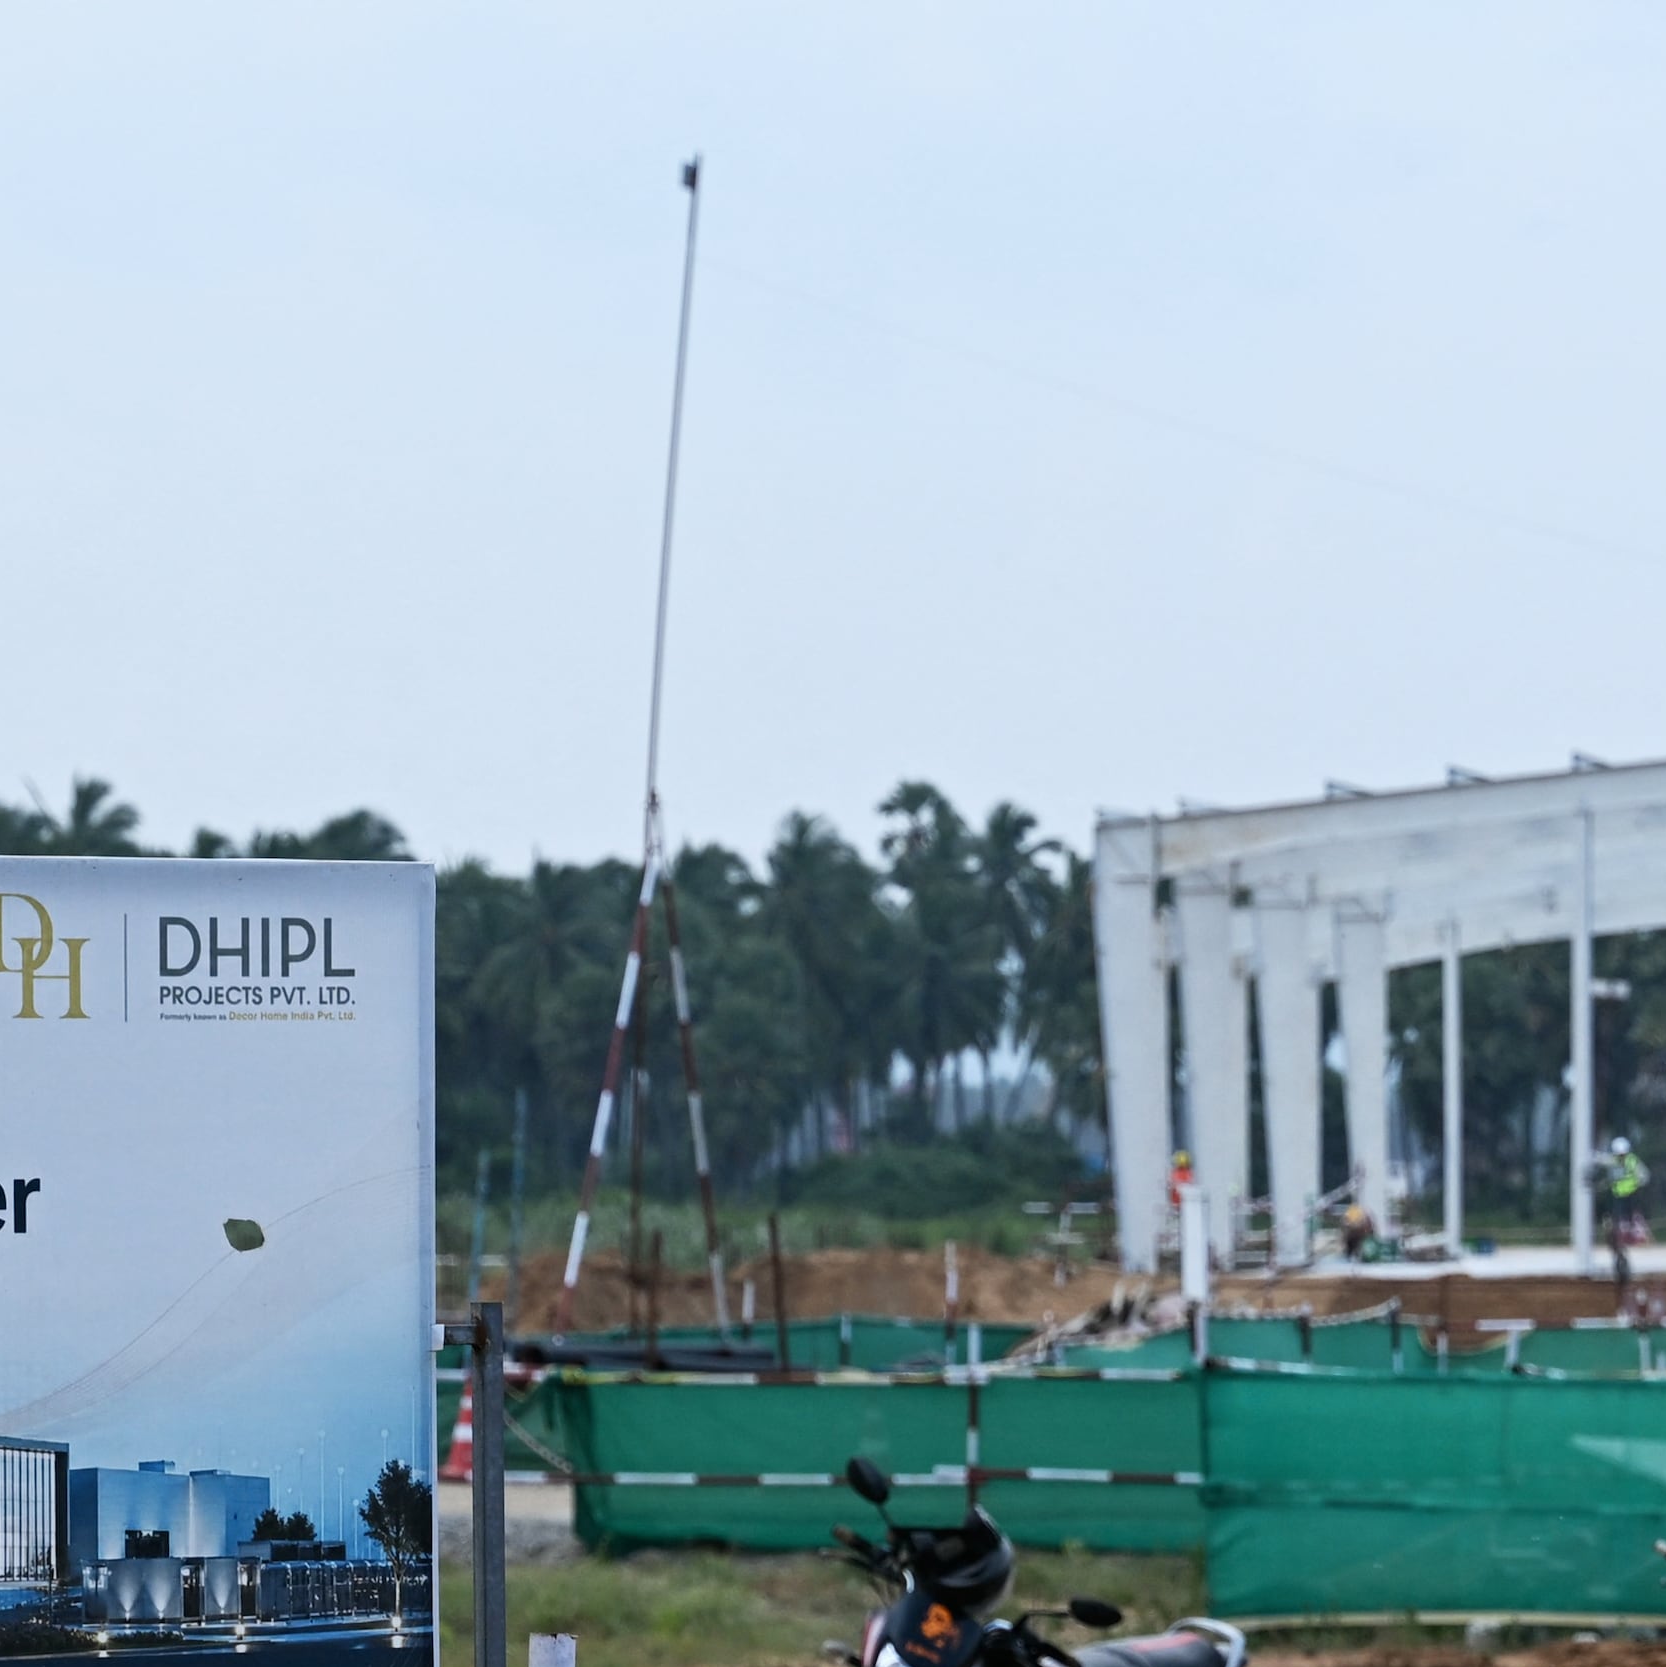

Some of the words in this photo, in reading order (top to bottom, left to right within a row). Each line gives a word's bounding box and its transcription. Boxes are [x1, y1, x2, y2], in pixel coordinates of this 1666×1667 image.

[159, 917, 355, 977] DHIPL
[160, 986, 262, 1005] PROJECTS
[270, 987, 310, 1005] PVT.
[319, 987, 355, 1004] LTD.
[160, 1012, 191, 1022] Formerly
[229, 1011, 257, 1020] Decor
[260, 1011, 288, 1020] Home
[291, 1011, 314, 1020] India
[317, 1011, 335, 1020] Pvt.
[338, 1011, 356, 1020] Ltd.
